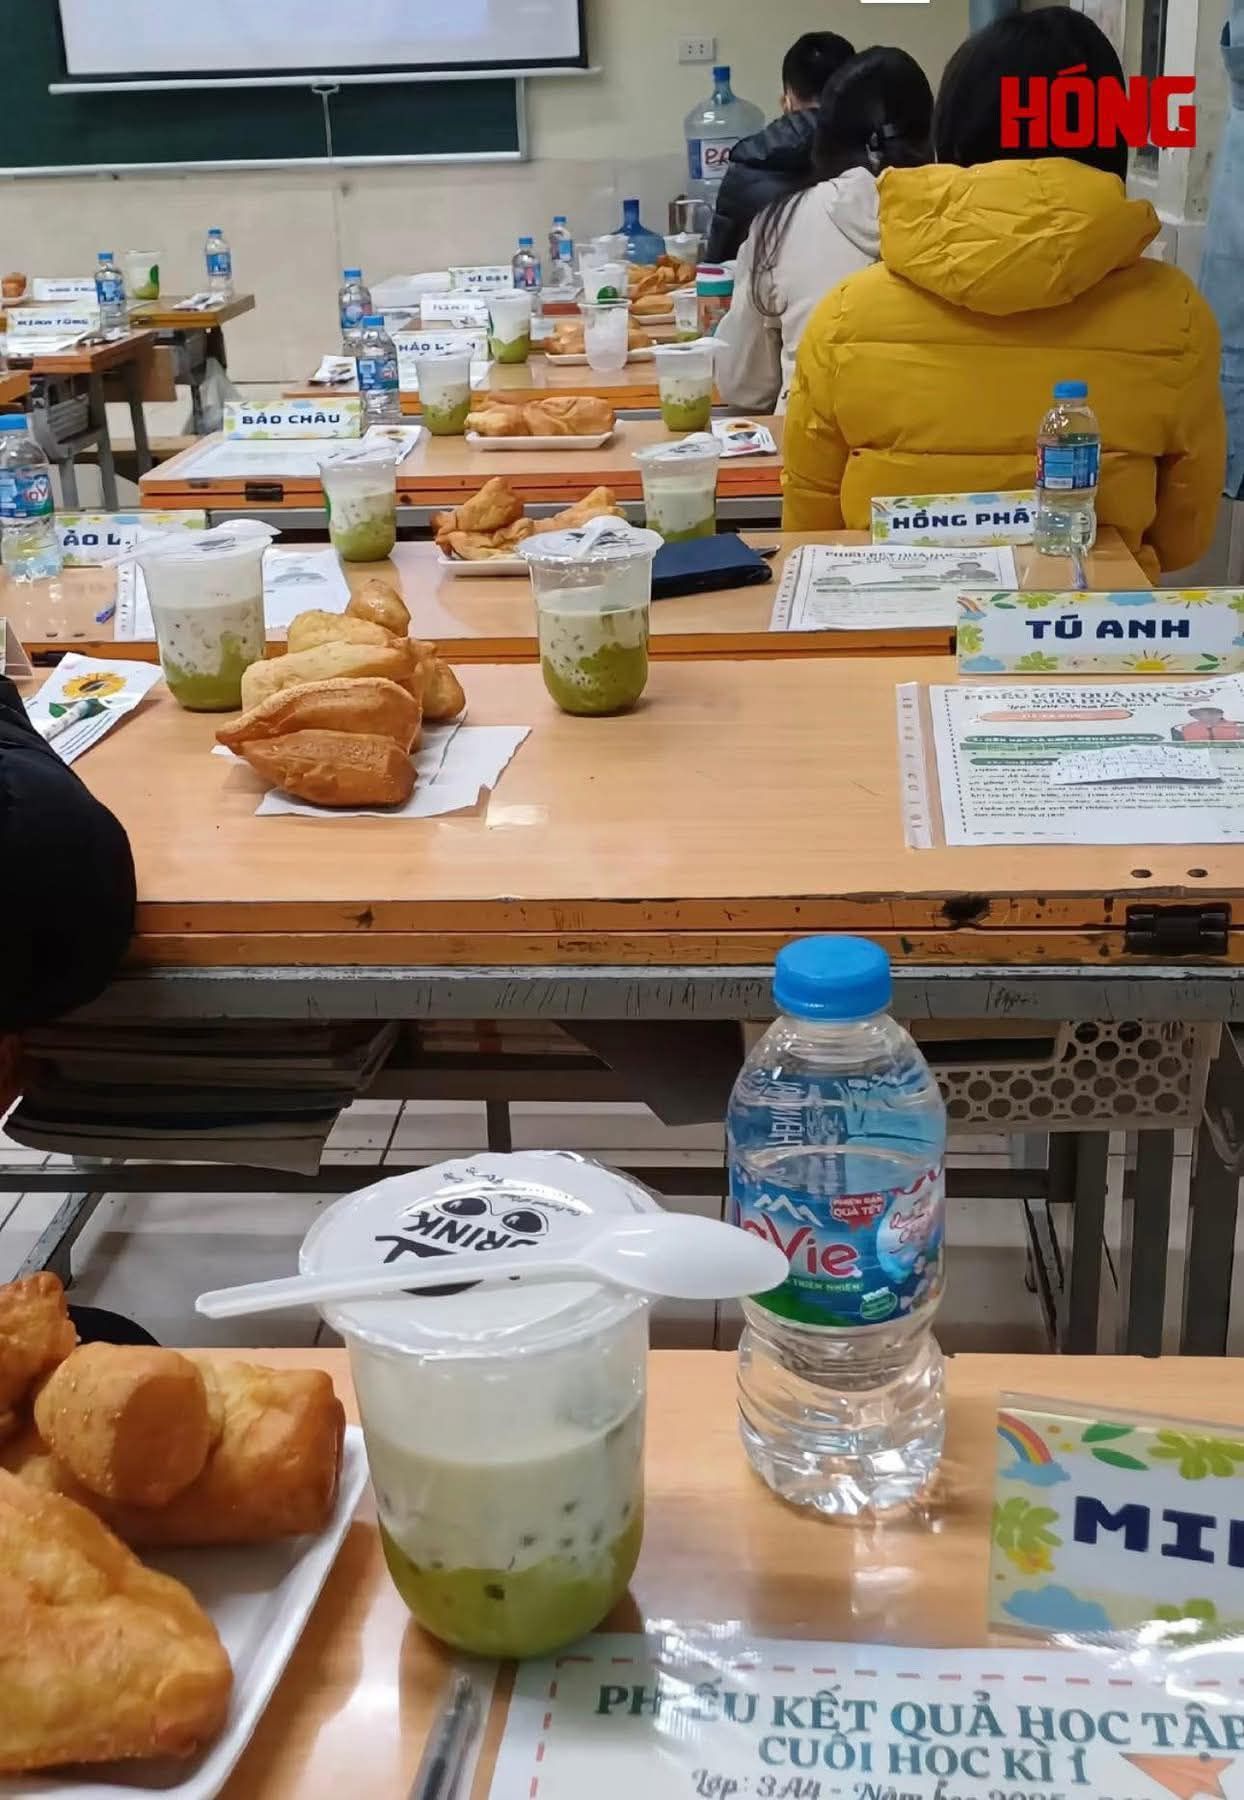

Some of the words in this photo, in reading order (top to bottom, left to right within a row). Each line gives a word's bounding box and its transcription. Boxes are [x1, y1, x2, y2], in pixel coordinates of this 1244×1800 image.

[242, 411, 282, 425] BẢO
[288, 411, 341, 424] CHÂU
[975, 508, 1036, 526] PHÁ
[1025, 614, 1083, 640] TÚ
[1096, 618, 1190, 639] ANH
[772, 1684, 877, 1732] KẾT
[890, 1689, 1006, 1742] QUẢ
[758, 1730, 874, 1774] CUỐI
